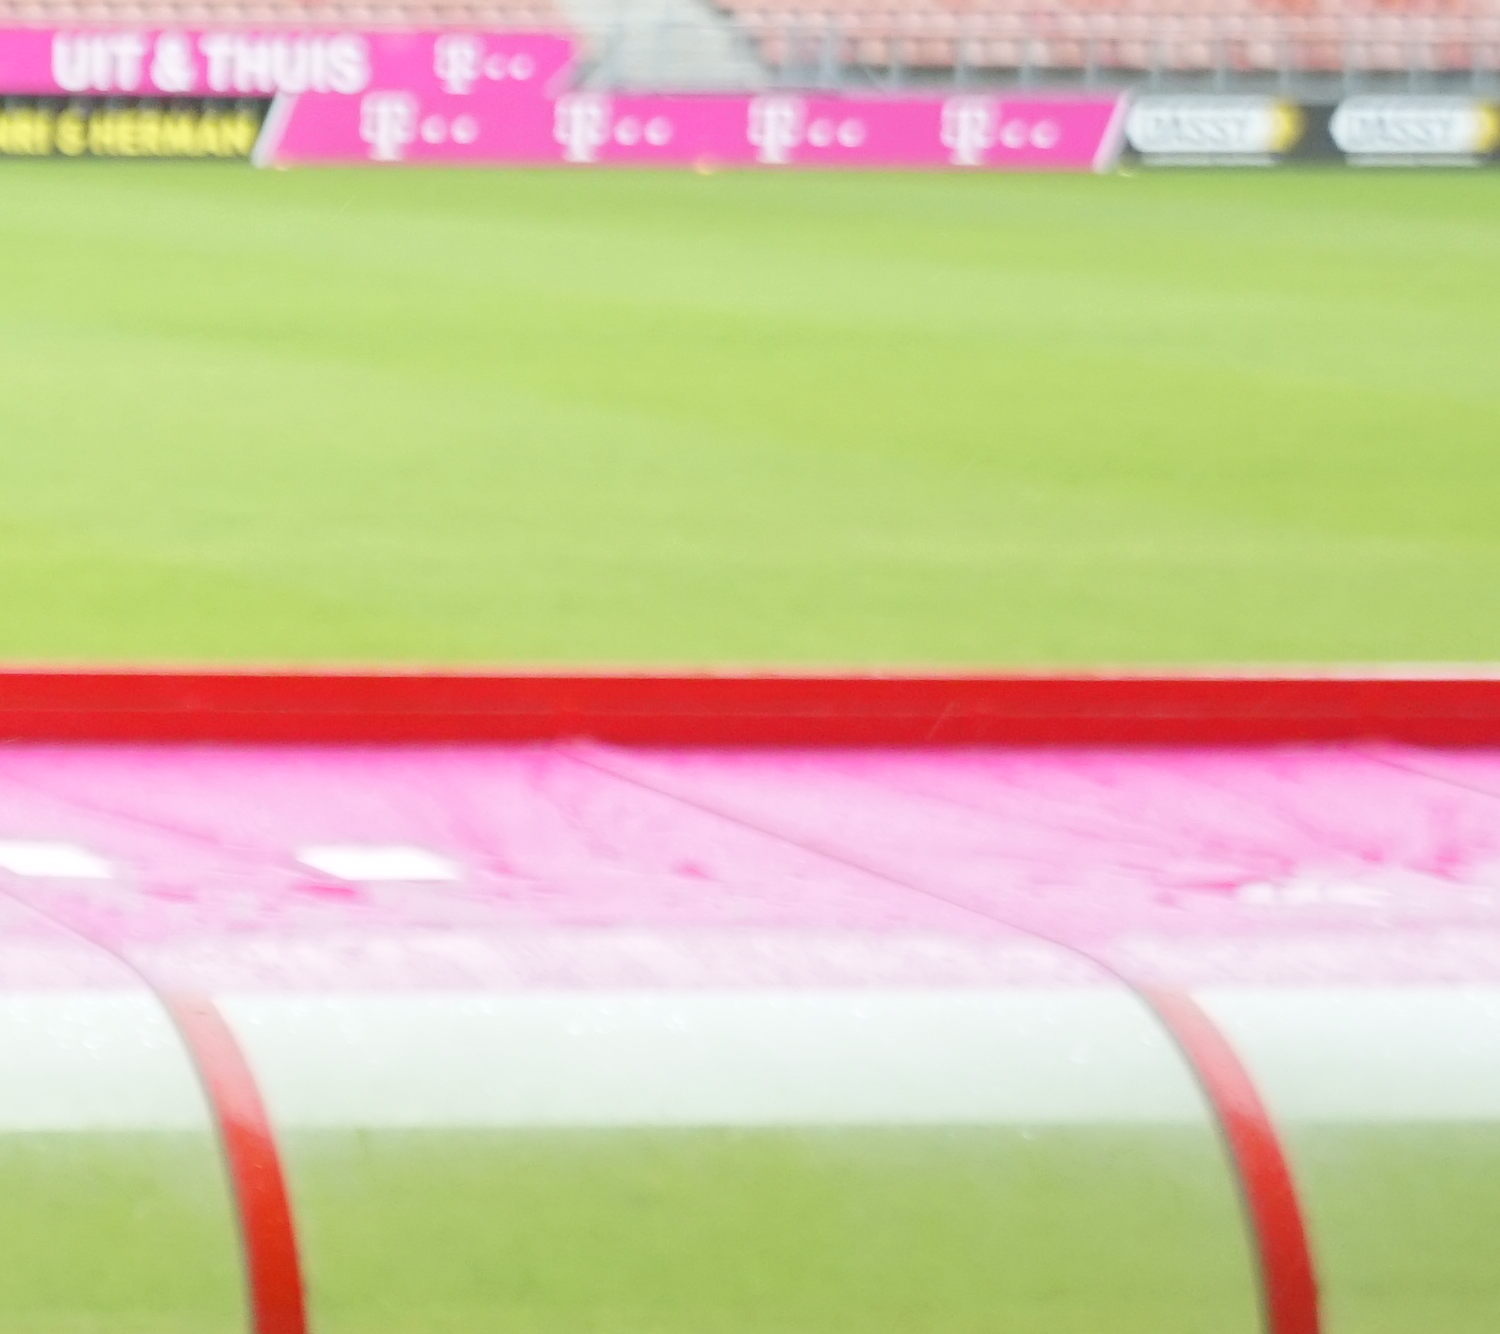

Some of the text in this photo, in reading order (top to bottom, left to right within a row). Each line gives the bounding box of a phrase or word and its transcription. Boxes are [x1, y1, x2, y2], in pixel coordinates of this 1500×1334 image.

[50, 29, 370, 97] UIT & THUIS
